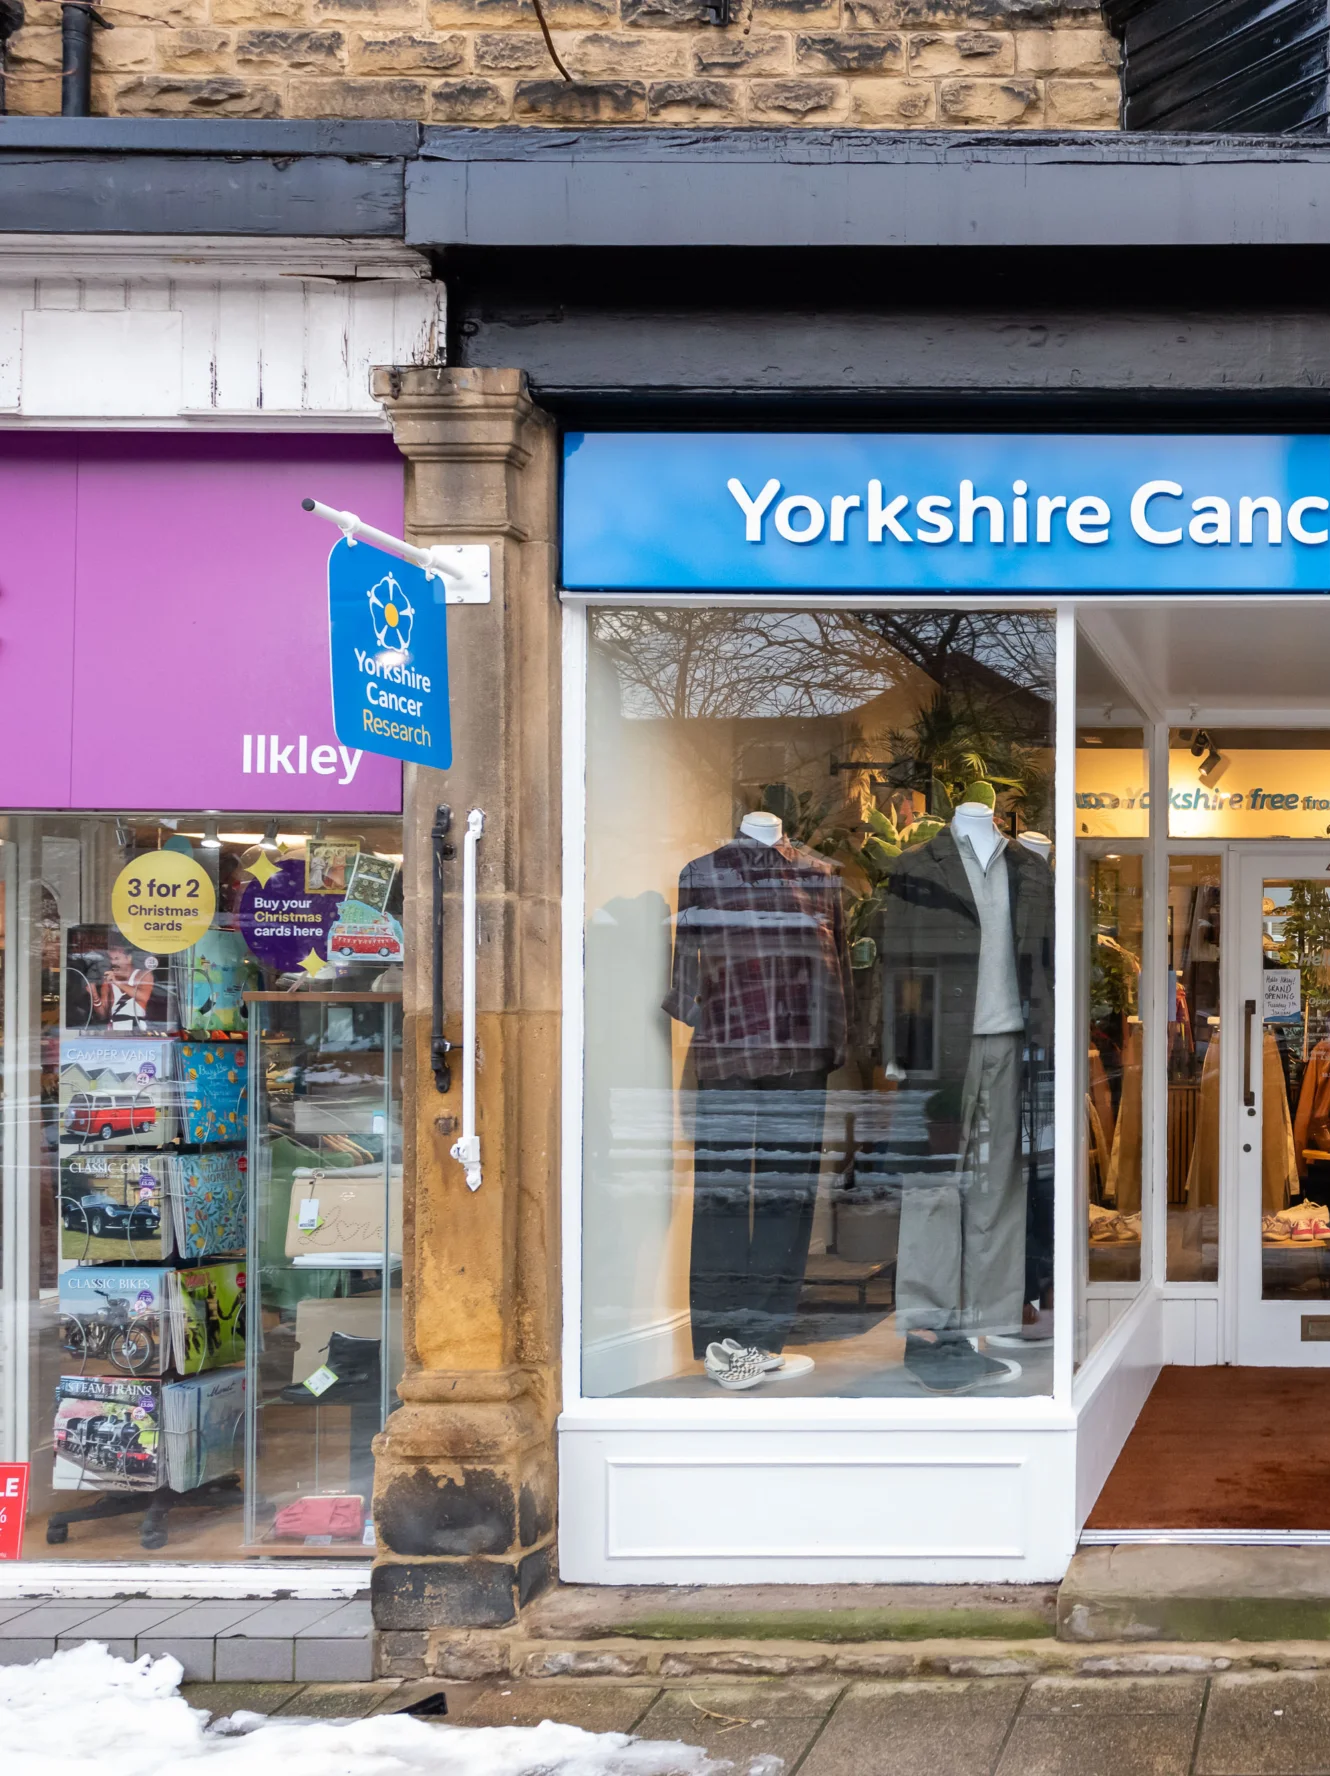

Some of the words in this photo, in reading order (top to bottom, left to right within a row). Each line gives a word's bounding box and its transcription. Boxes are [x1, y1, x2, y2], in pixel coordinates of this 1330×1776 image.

[726, 478, 1111, 545] Yorkshire
[354, 647, 431, 693] Yorkshire
[366, 681, 423, 717] Cancer
[363, 708, 431, 747] Research
[242, 734, 363, 785] Ilkley
[1248, 788, 1299, 810] free
[127, 878, 142, 898] 3
[146, 878, 181, 898] for
[186, 879, 200, 898] 2
[128, 904, 199, 917] Christmas
[254, 897, 279, 911] Buy
[282, 899, 312, 911] your
[254, 911, 322, 923] Christmas
[143, 920, 183, 931] cards
[254, 925, 291, 936] cards
[293, 925, 323, 936] here
[1267, 984, 1292, 993] GRAND
[1264, 992, 1295, 1000] OPENING
[67, 1048, 118, 1061] CAMPER
[121, 1049, 157, 1061] VANS
[69, 1163, 117, 1173] CLASSIC
[120, 1163, 152, 1173] CARS
[68, 1278, 115, 1289] CLASSIC
[119, 1278, 150, 1289] BIKES
[67, 1382, 105, 1394] STEAM
[110, 1384, 152, 1396] TRAINS
